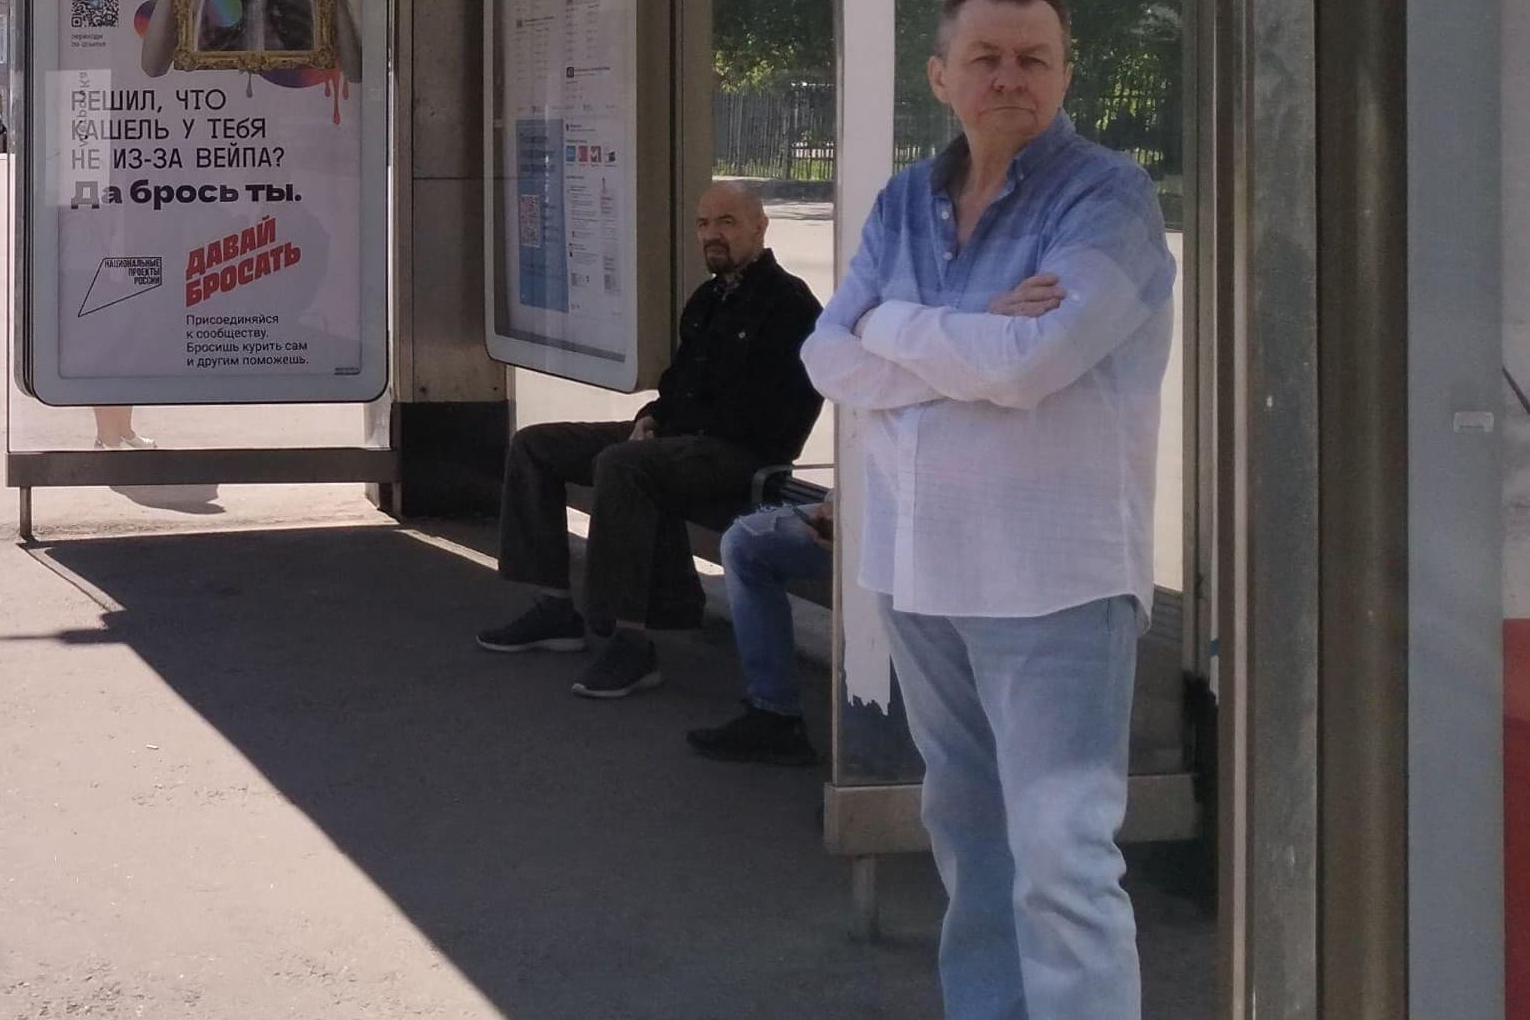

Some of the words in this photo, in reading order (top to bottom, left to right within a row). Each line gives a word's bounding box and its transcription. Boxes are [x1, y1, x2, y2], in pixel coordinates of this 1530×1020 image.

[71, 90, 162, 114] РЕШИЛ,
[176, 89, 226, 111] ЧТО
[71, 118, 169, 140] КАШЕЛЬ
[183, 118, 195, 139] У
[71, 148, 100, 169] НЕ
[113, 147, 183, 169] ИЗ-ЗА
[196, 142, 285, 168] ВЕЙПА?
[71, 181, 123, 209] Да
[130, 179, 239, 210] брось
[245, 184, 302, 202] ты.
[186, 215, 276, 281] ДАВАЙ
[105, 259, 160, 268] НАЦИОНАЛЬНЫЕ
[128, 268, 160, 277] ПРОЕКТЫ
[186, 242, 301, 308] БРОСАТЬ
[134, 276, 160, 285] РОССИИ
[186, 314, 279, 326] Присоединяйся
[186, 330, 193, 339] к
[196, 327, 269, 340] сообществу.
[186, 342, 239, 354] Бросишь
[243, 342, 282, 353] курить
[285, 341, 308, 351] сам
[186, 357, 194, 366] и
[197, 356, 239, 368] другим
[243, 355, 309, 365] поможешь.
